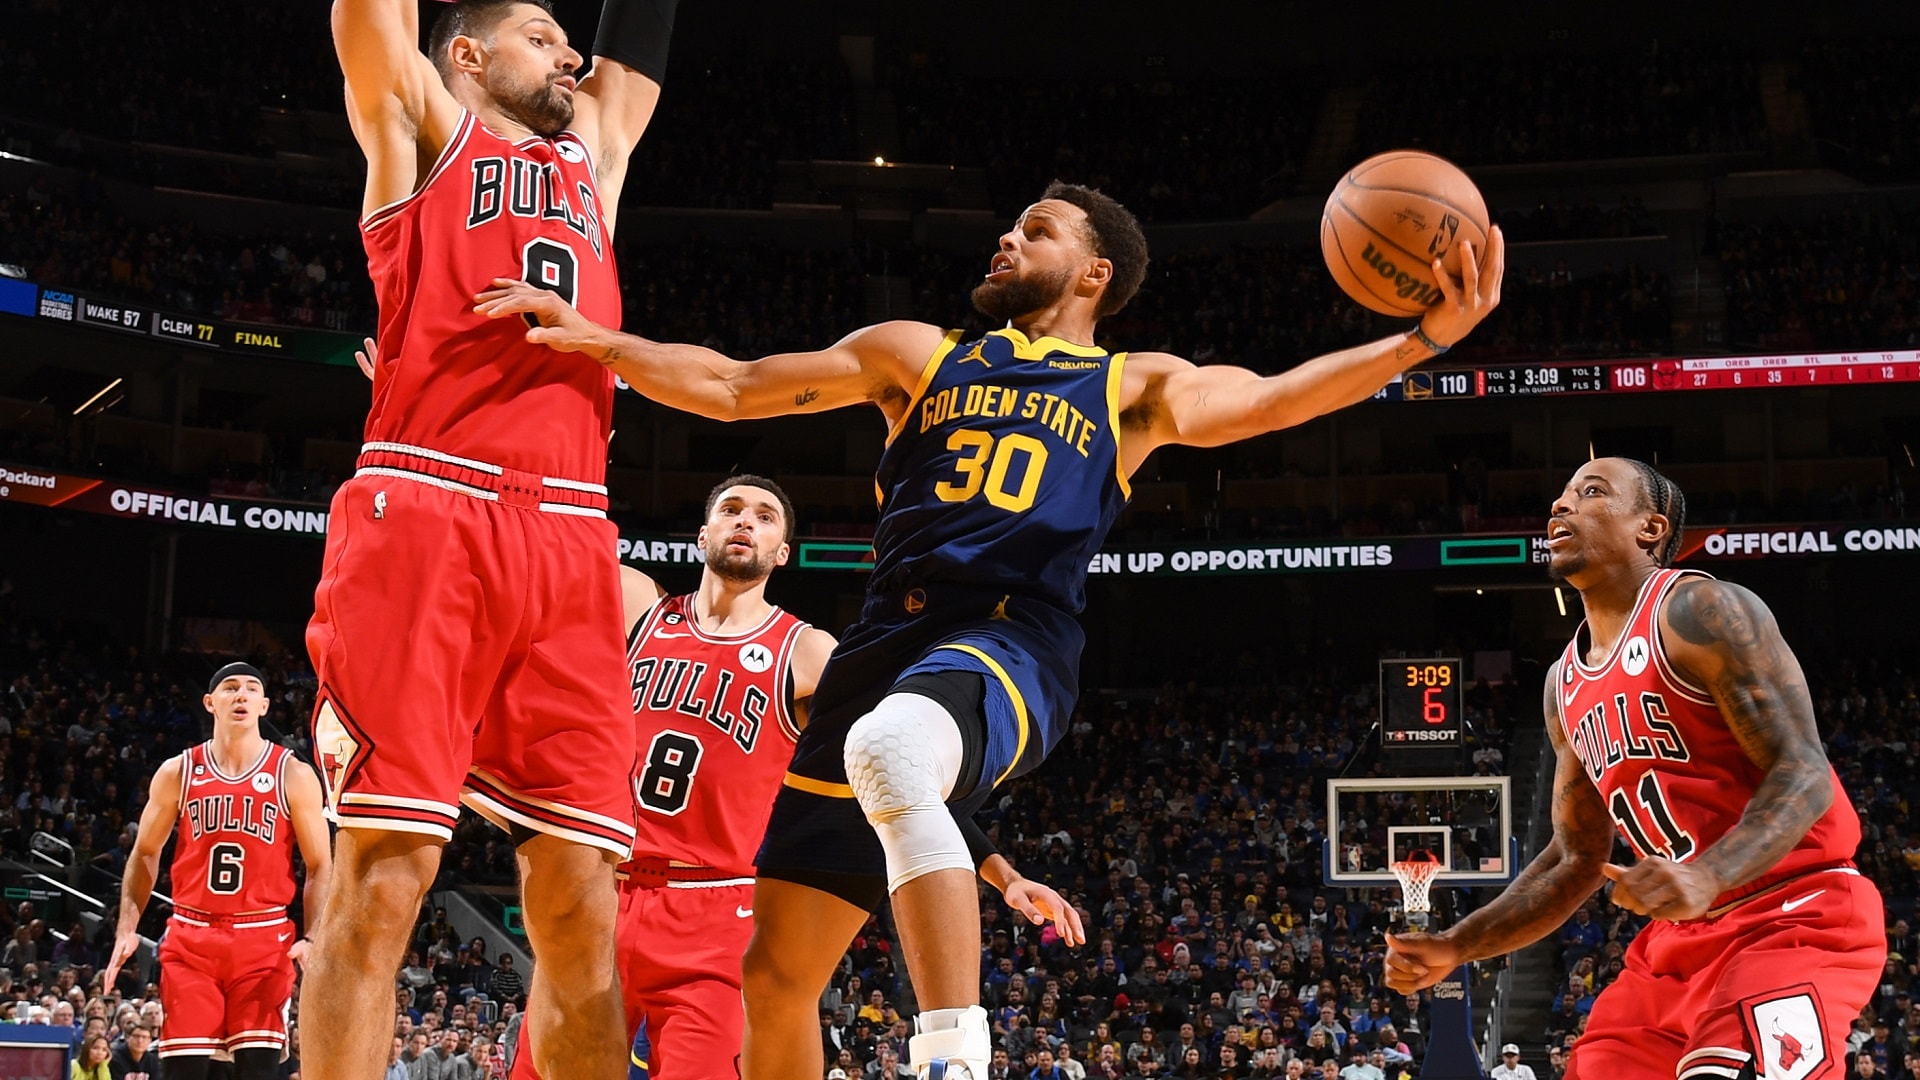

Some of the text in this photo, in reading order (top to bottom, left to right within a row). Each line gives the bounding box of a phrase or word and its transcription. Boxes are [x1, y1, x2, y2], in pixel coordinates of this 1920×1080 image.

[466, 156, 603, 263] BULLS
[43, 290, 74, 304] NCAA
[40, 306, 73, 321] SCORES
[87, 304, 141, 327] WAKE 57
[161, 319, 282, 348] CLEM 77 FINAL
[1049, 360, 1101, 369] Rakuten
[1572, 368, 1589, 376] TOL
[1725, 359, 1750, 367] OREB
[1440, 374, 1467, 394] 110
[1487, 370, 1516, 380] TOL 3
[1524, 368, 1559, 385] 3:09
[1614, 367, 1646, 387] 106
[1694, 374, 1707, 386] 27
[1734, 372, 1741, 384] 6
[1768, 371, 1781, 383] 35
[1809, 369, 1815, 382] 7
[1882, 367, 1893, 379] 12
[1488, 383, 1516, 394] FLS 3
[1531, 386, 1565, 394] QUARTER
[1572, 382, 1589, 390] FLS
[920, 385, 1097, 458] GOLDEN STATE
[0, 469, 56, 489] Packard
[935, 429, 1048, 513] 30
[110, 489, 236, 526] OFFICIAL
[1704, 530, 1837, 556] OFFICIAL
[1128, 552, 1164, 573] UP
[1170, 545, 1393, 572] OPPORTUNITIES
[1406, 665, 1451, 687] 3:09
[631, 656, 770, 755] BULLS
[1423, 687, 1446, 723] 6
[1405, 730, 1458, 741] TISSOT
[635, 729, 704, 817] 8
[187, 794, 279, 845] BULLS
[1608, 768, 1696, 864] 11
[207, 841, 245, 896] 6
